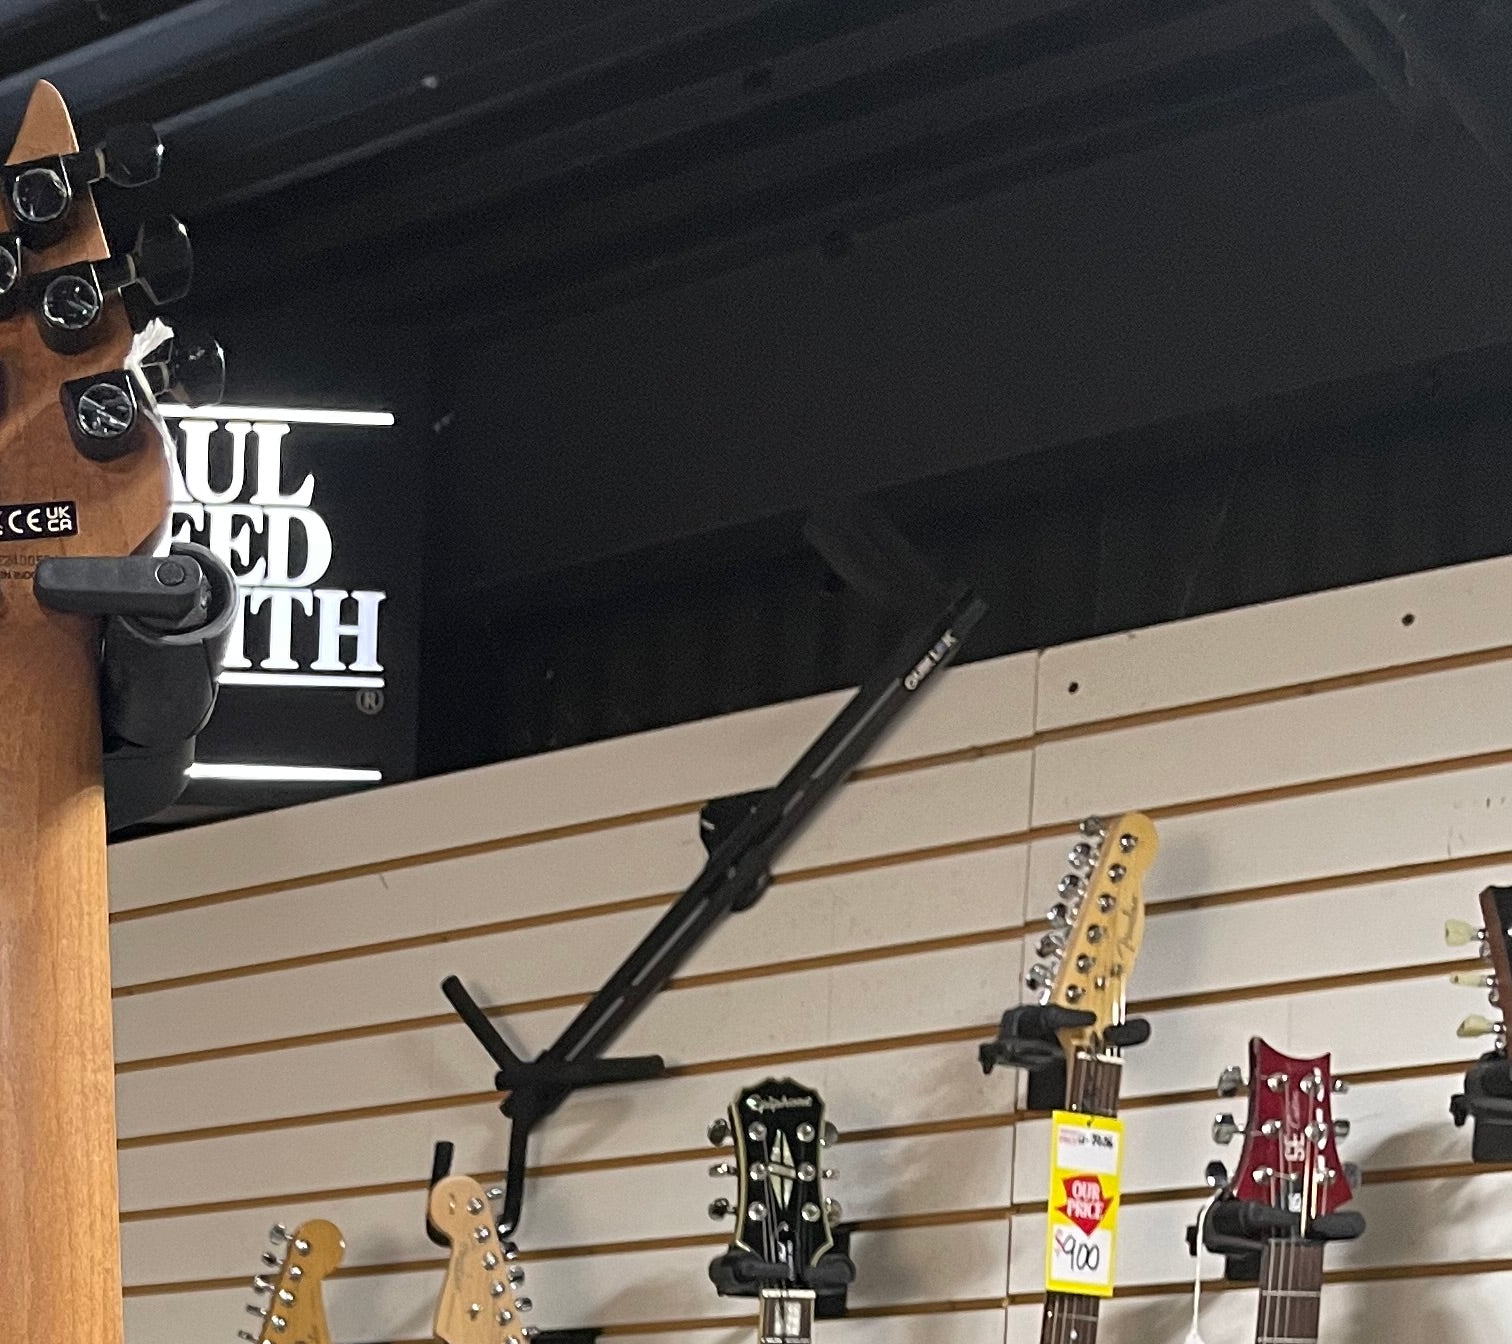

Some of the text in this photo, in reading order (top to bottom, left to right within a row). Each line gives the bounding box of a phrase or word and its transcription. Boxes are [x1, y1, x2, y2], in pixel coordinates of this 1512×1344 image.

[7, 508, 43, 534] CE
[45, 505, 71, 520] UK
[47, 518, 73, 532] CA
[1071, 1178, 1101, 1201] OUR
[1066, 1196, 1105, 1221] PRICE
